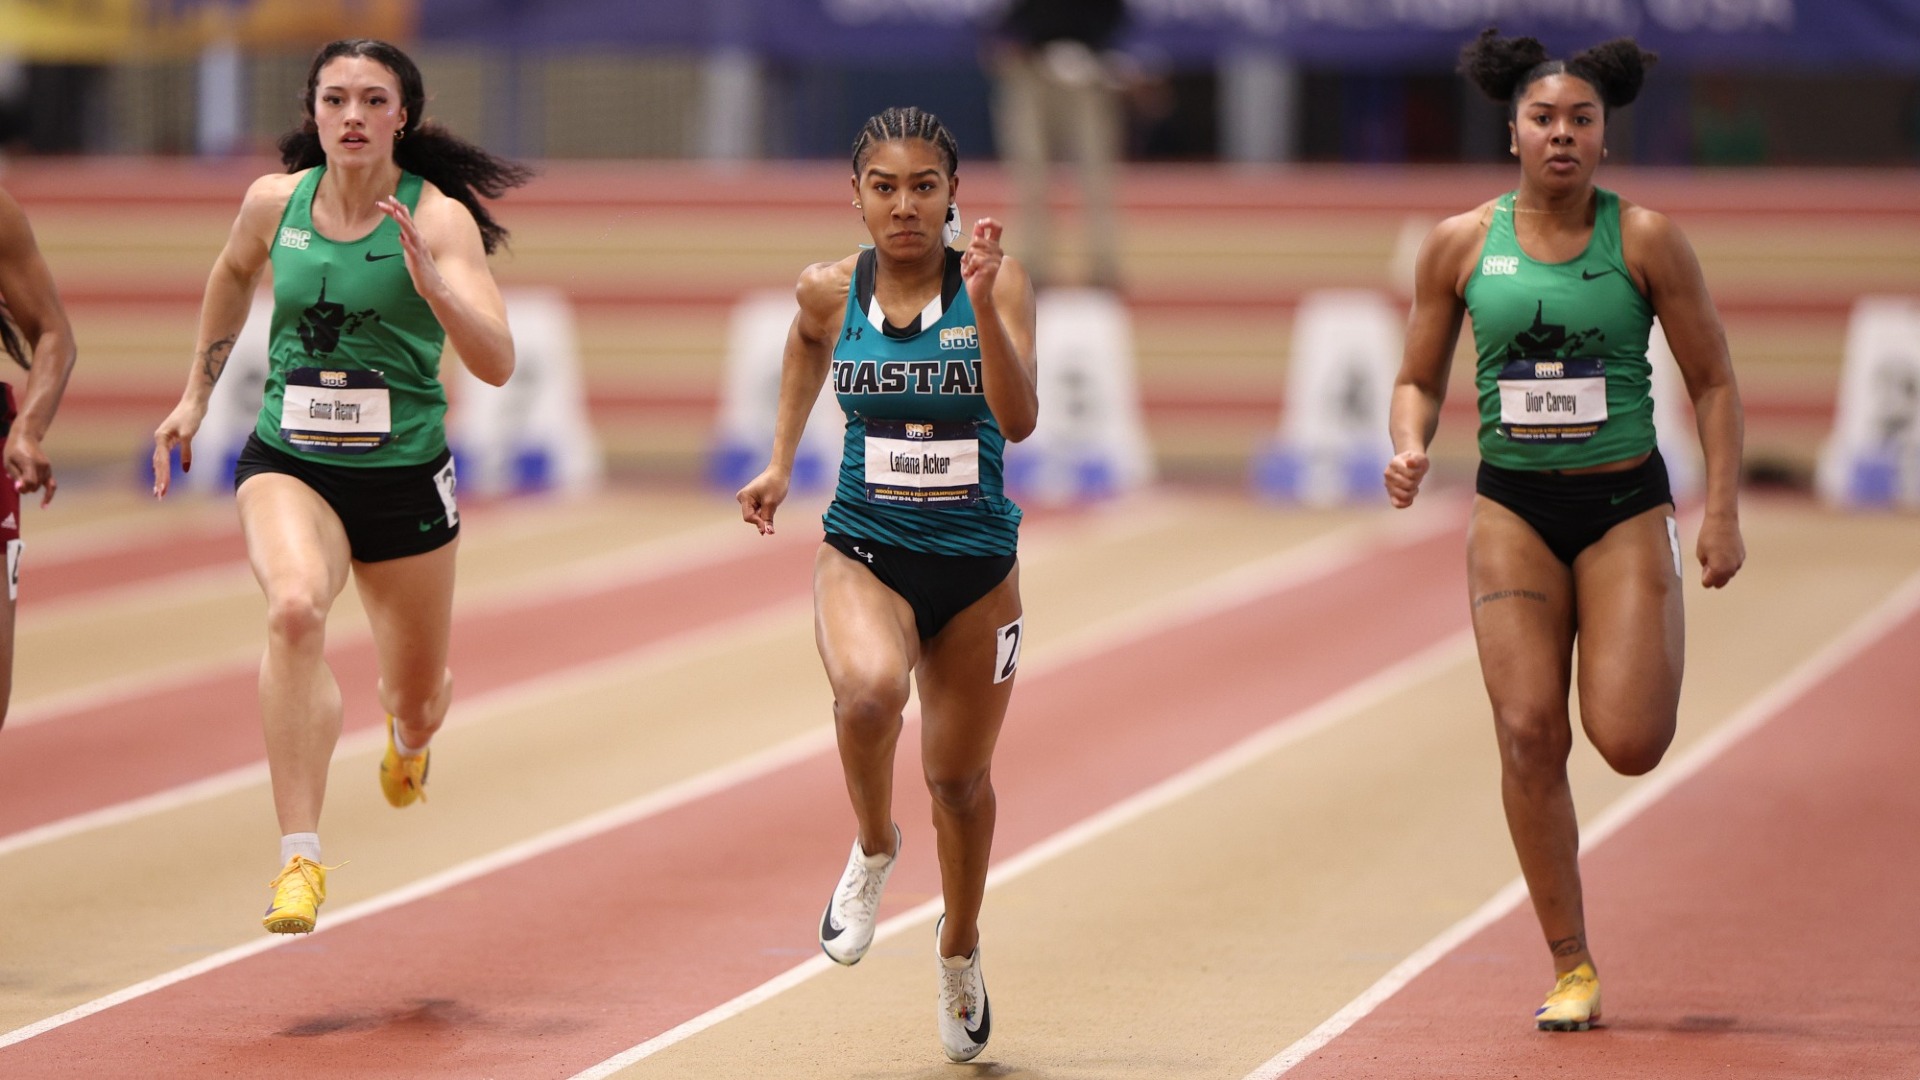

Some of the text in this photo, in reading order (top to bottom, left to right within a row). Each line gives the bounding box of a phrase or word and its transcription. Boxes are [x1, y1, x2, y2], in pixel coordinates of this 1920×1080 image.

[280, 226, 312, 250] SBC
[1482, 255, 1519, 276] SBC
[940, 326, 978, 349] SBC
[1525, 391, 1576, 416] Dior Carney
[905, 423, 934, 439] SBC
[889, 450, 951, 475] Latiana Acker
[1000, 623, 1020, 680] 2
